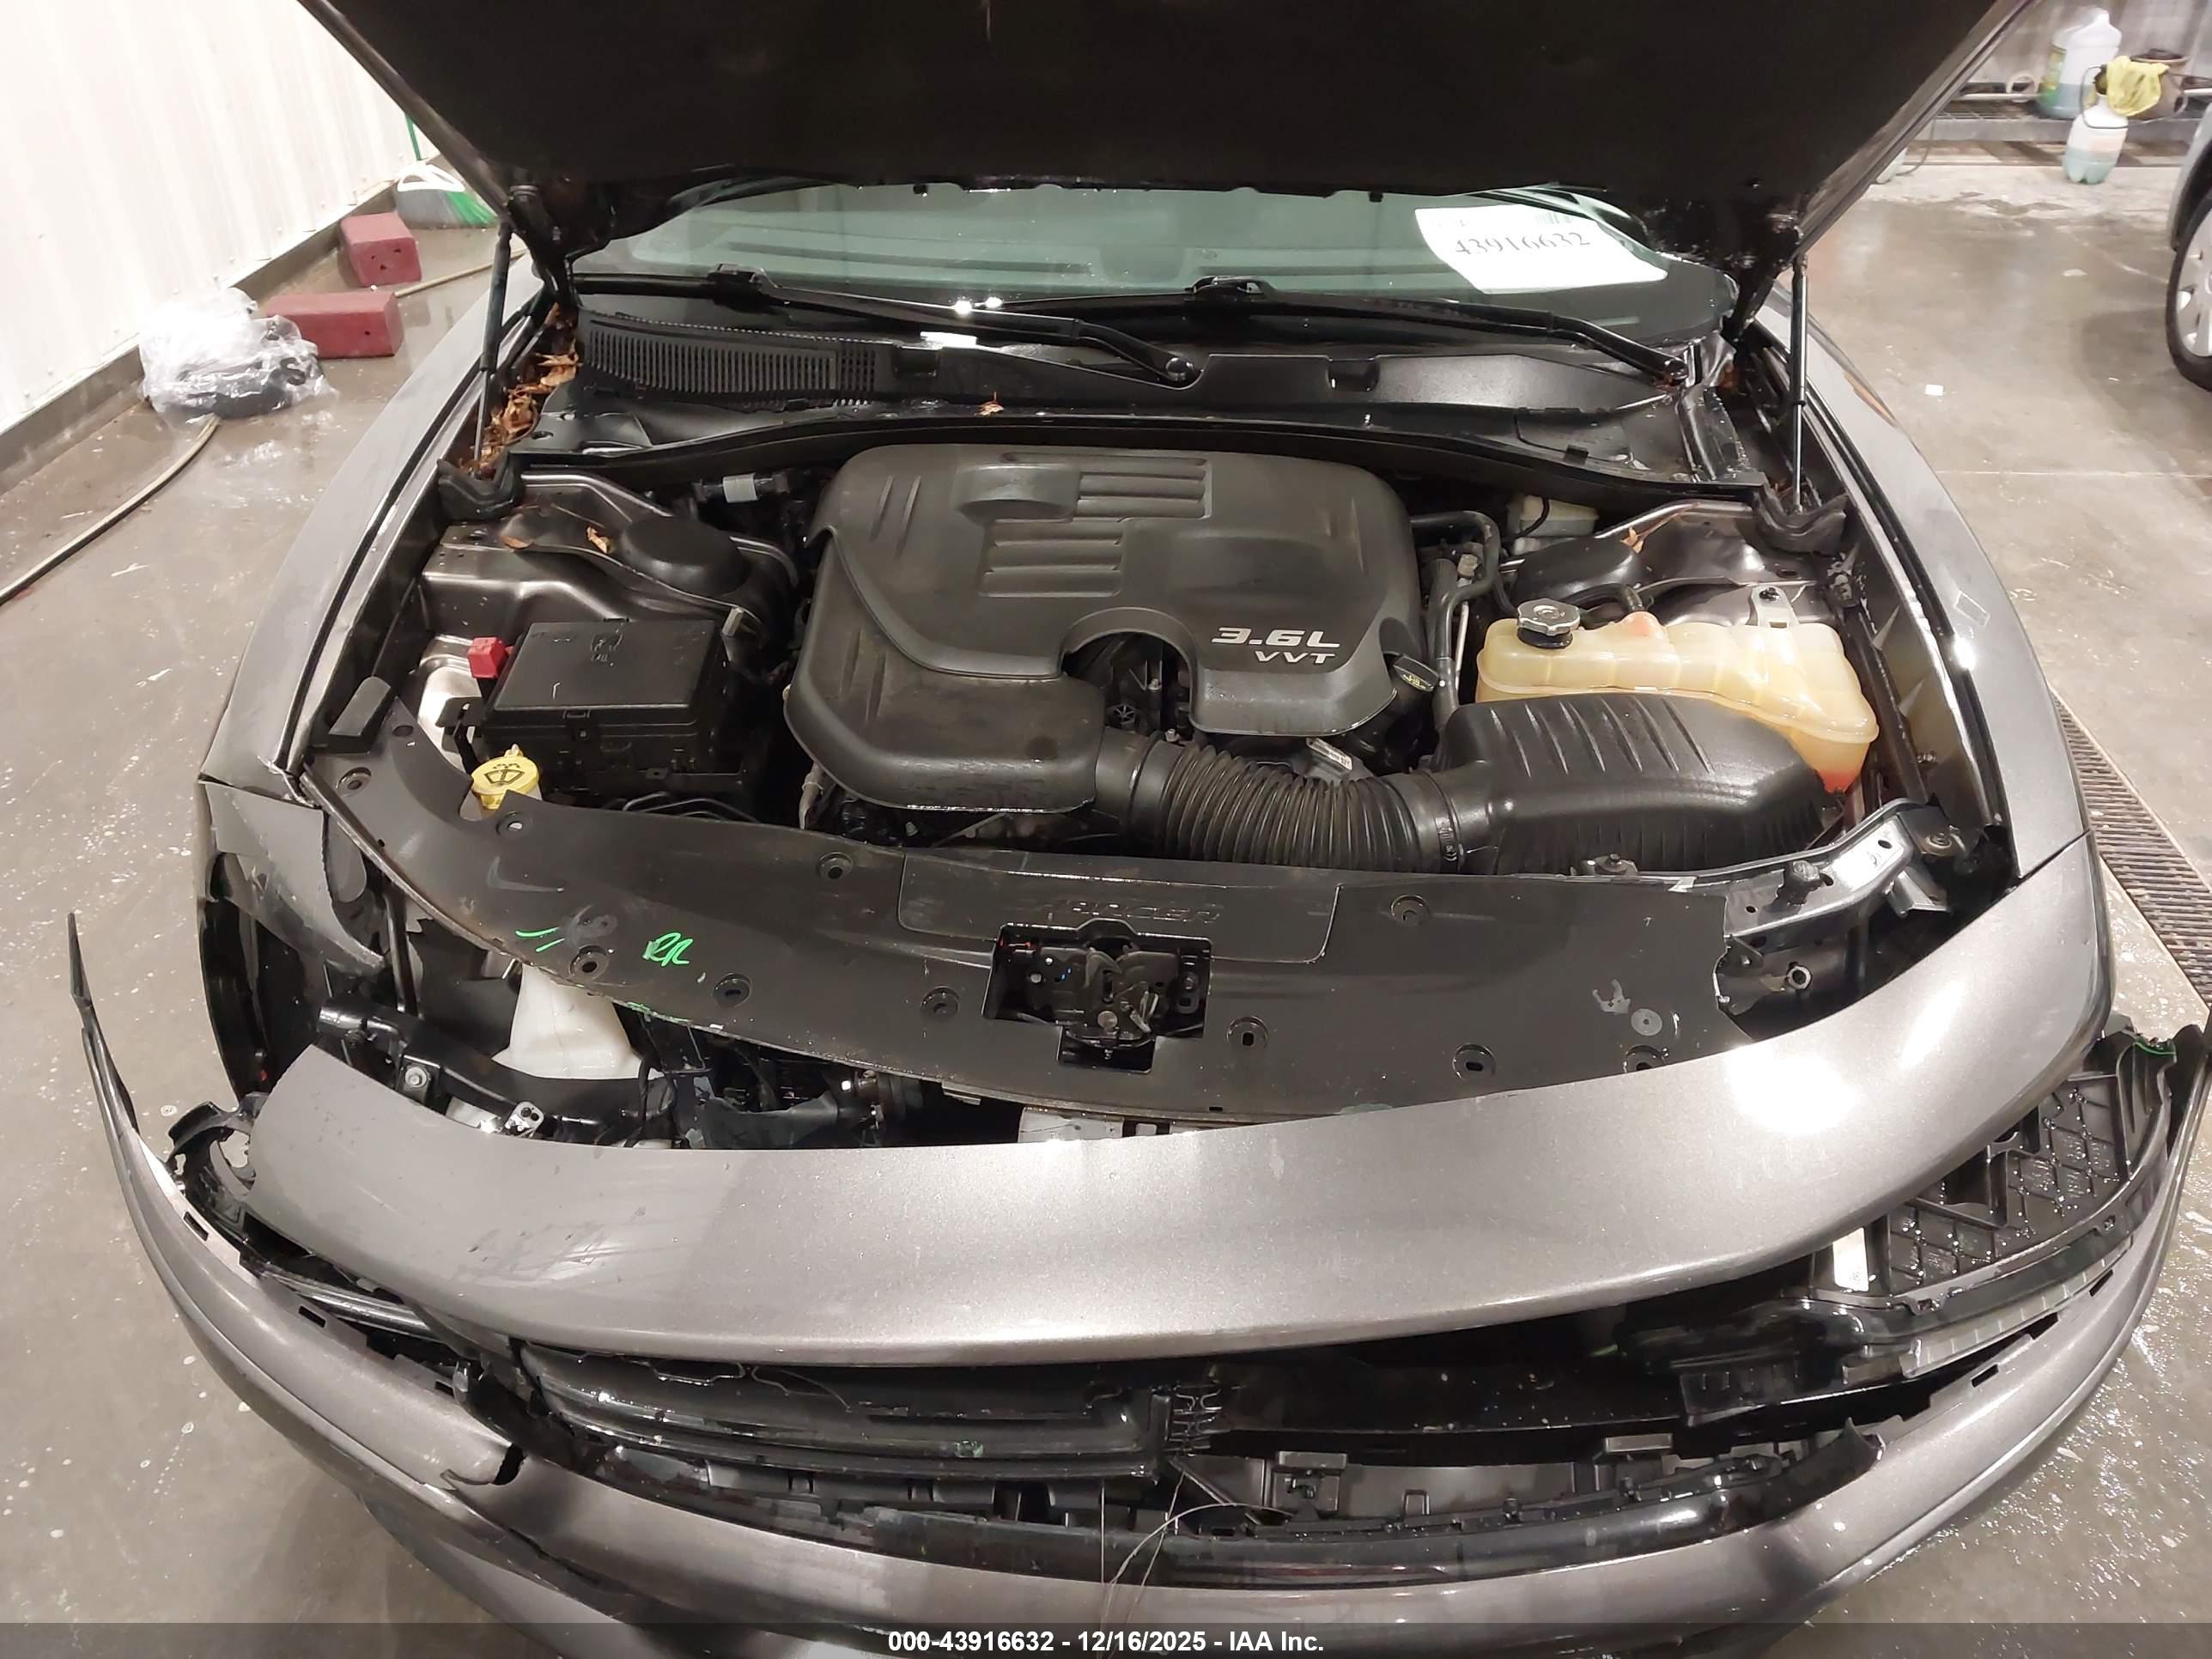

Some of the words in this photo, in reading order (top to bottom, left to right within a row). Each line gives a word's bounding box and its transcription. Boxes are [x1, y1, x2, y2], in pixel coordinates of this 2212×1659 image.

[1455, 232, 1590, 255] 43916632
[1211, 627, 1340, 648] 3.6L
[1255, 651, 1336, 664] VVT
